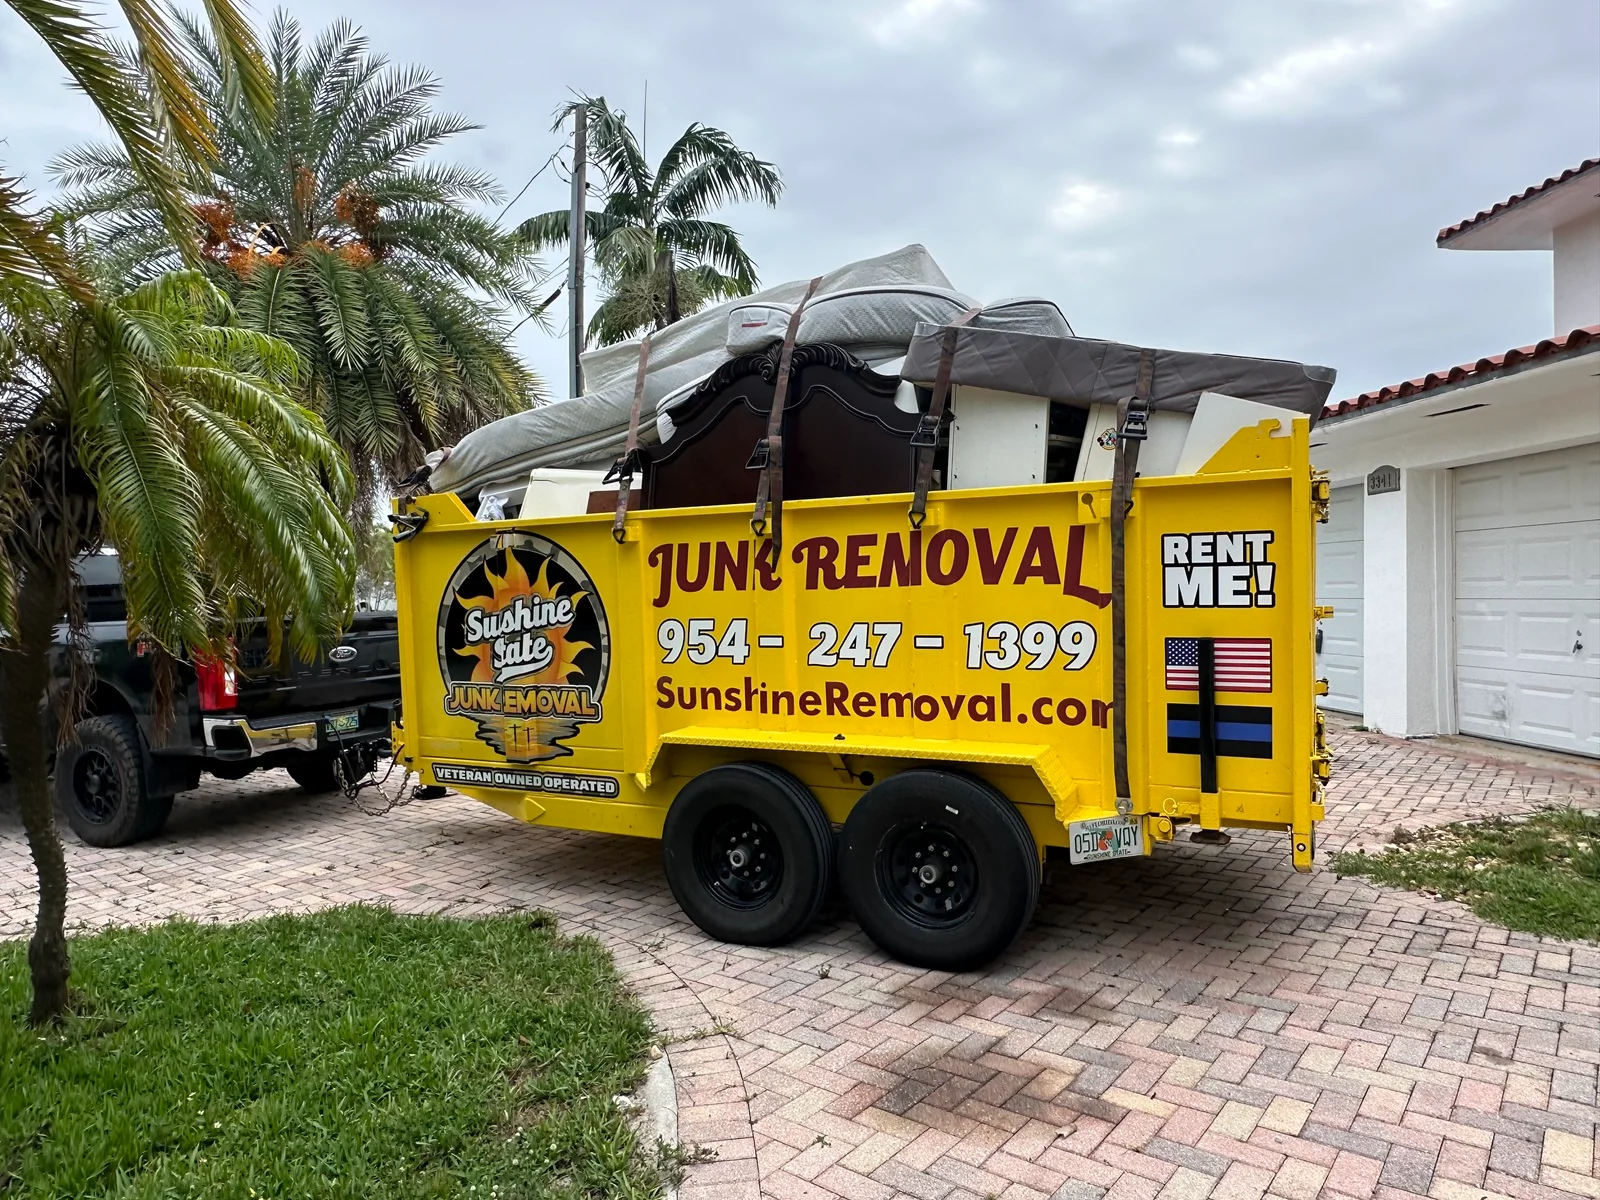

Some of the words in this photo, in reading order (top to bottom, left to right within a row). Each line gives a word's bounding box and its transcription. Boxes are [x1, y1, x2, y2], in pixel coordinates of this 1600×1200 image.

[1370, 473, 1392, 490] 3341
[1162, 531, 1274, 564] RENT
[648, 538, 782, 608] JUNK
[792, 525, 1112, 610] REMOVAL
[1163, 563, 1275, 607] ME!
[466, 595, 574, 642] Sushine
[657, 618, 750, 665] 954
[807, 622, 902, 668] 247
[963, 621, 1097, 671] 1399
[450, 686, 501, 711] JUNK
[503, 688, 596, 716] EMOVAL
[435, 767, 492, 783] VETERAN
[494, 772, 542, 788] OWNED
[543, 776, 616, 793] OPERATED
[1114, 825, 1138, 849] VQY
